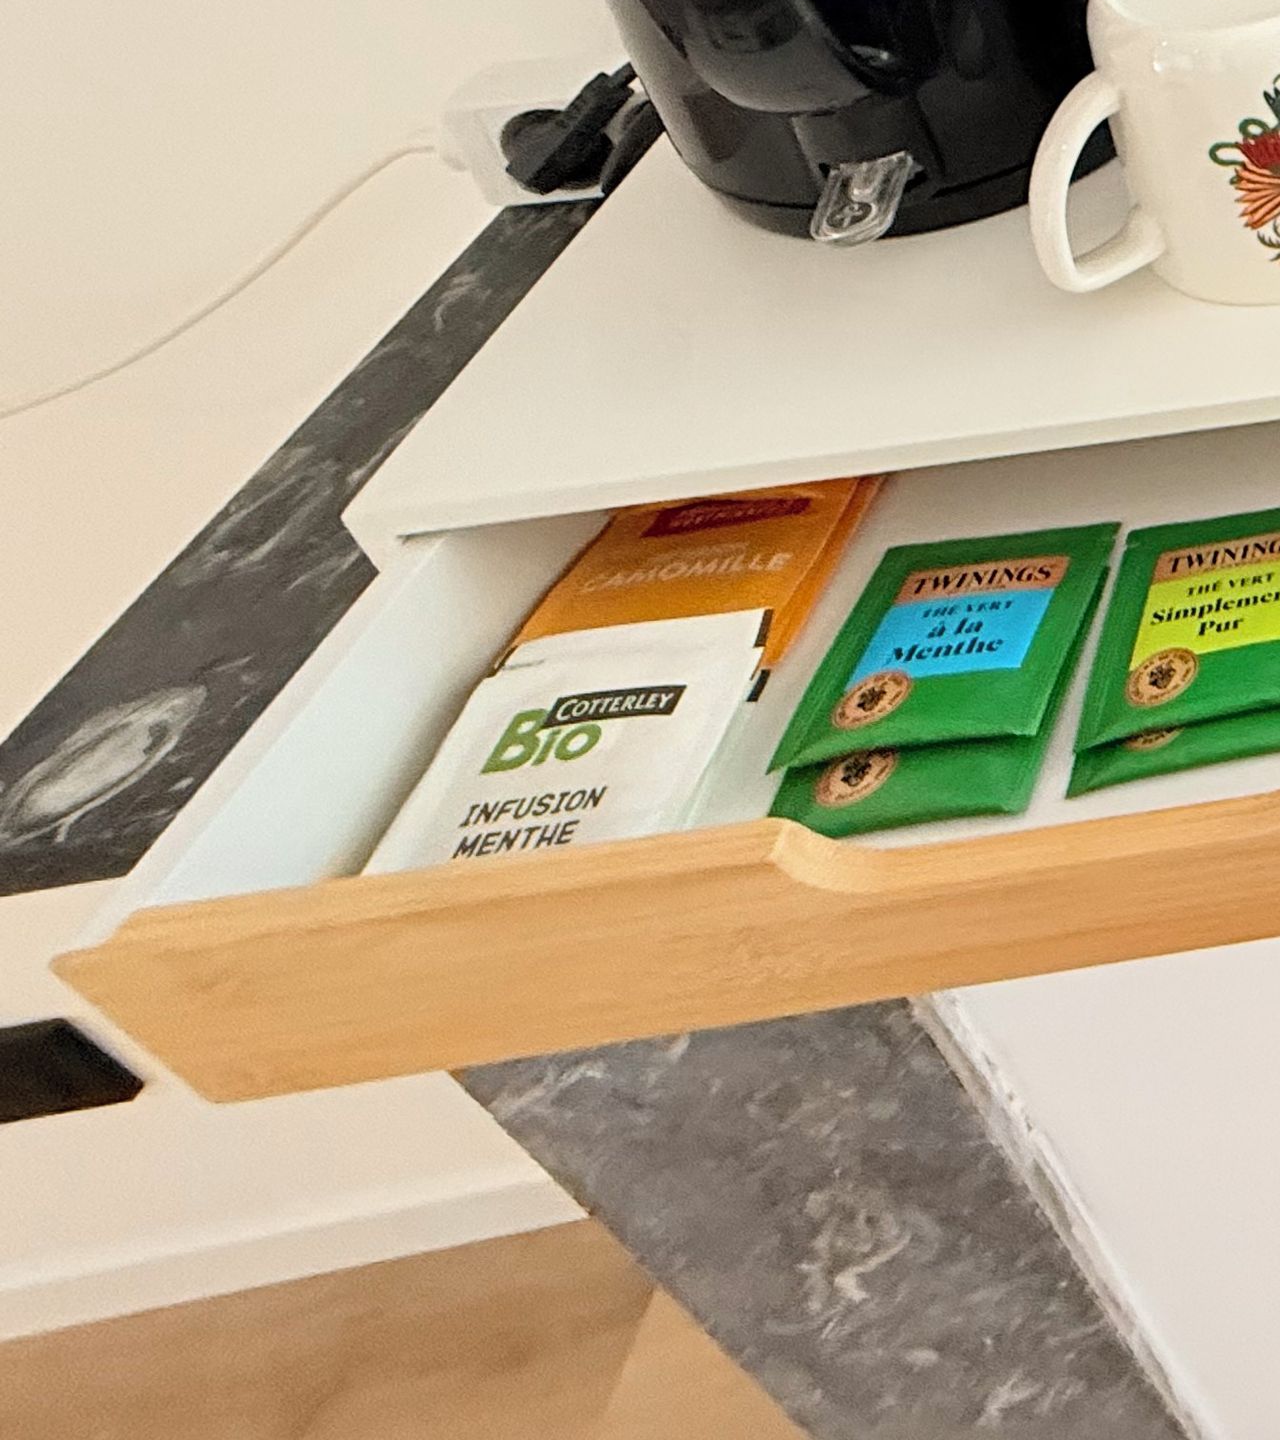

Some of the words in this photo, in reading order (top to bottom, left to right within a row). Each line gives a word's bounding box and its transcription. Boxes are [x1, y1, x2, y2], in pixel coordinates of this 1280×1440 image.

[580, 552, 793, 593] CAMOMILLE
[913, 563, 1056, 595] TWININGS
[1228, 572, 1275, 589] VERT
[966, 600, 1014, 613] VERT
[954, 617, 984, 635] la
[1198, 618, 1243, 636] Pur
[885, 636, 1004, 666] Menthe
[556, 692, 674, 721] COTTERLEY
[459, 785, 608, 827] INFUSION
[453, 820, 580, 859] MENTHE
